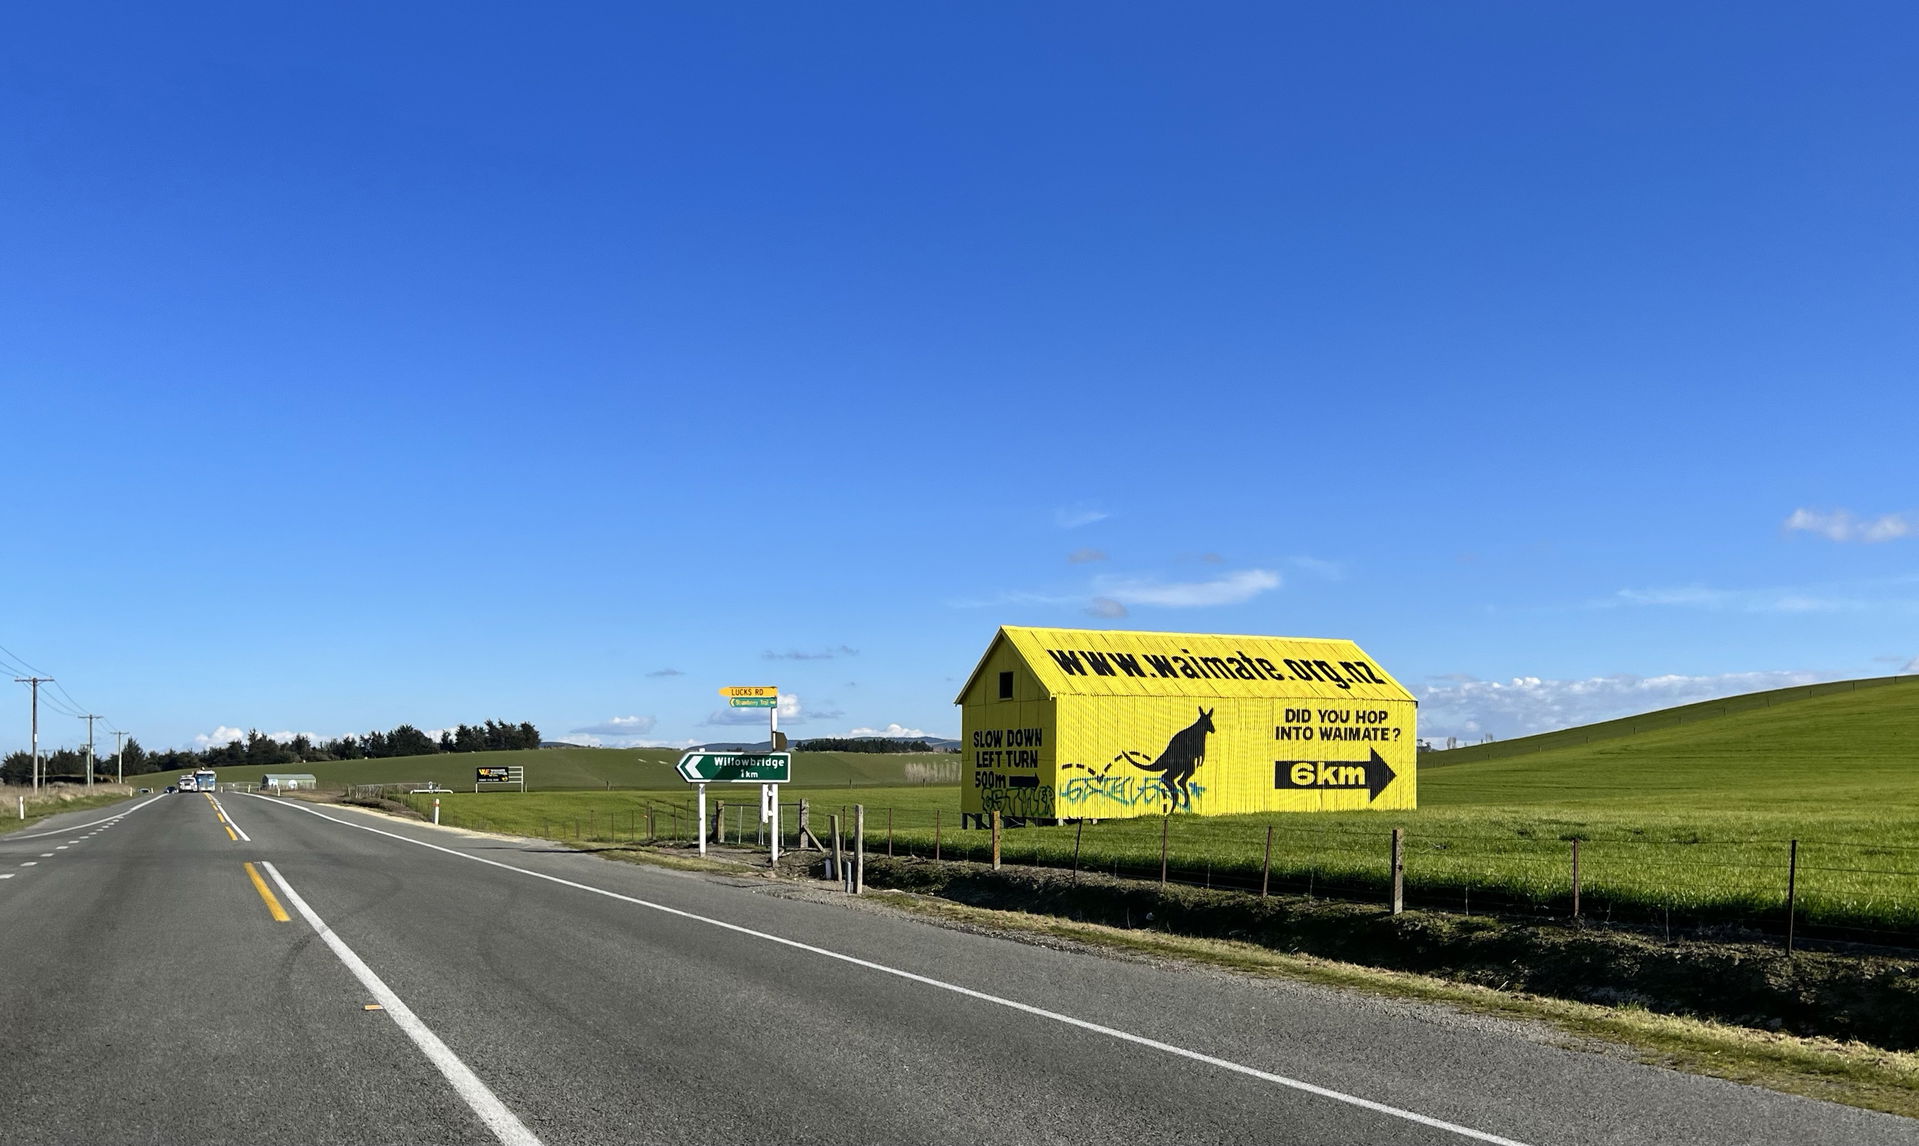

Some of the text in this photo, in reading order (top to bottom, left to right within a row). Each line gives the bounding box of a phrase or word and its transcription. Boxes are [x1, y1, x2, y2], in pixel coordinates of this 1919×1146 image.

[1047, 648, 1386, 689] www.waimate.org.nz
[731, 688, 764, 696] LUCKS RD
[1285, 708, 1388, 724] DID YOU HOP
[973, 728, 1042, 748] SLOW DOWN
[1275, 726, 1314, 741] INTO
[714, 757, 784, 769] Willowbridge
[976, 750, 1038, 768] LEFT TURN
[975, 771, 1006, 788] 500m
[1290, 762, 1365, 785] 6km
